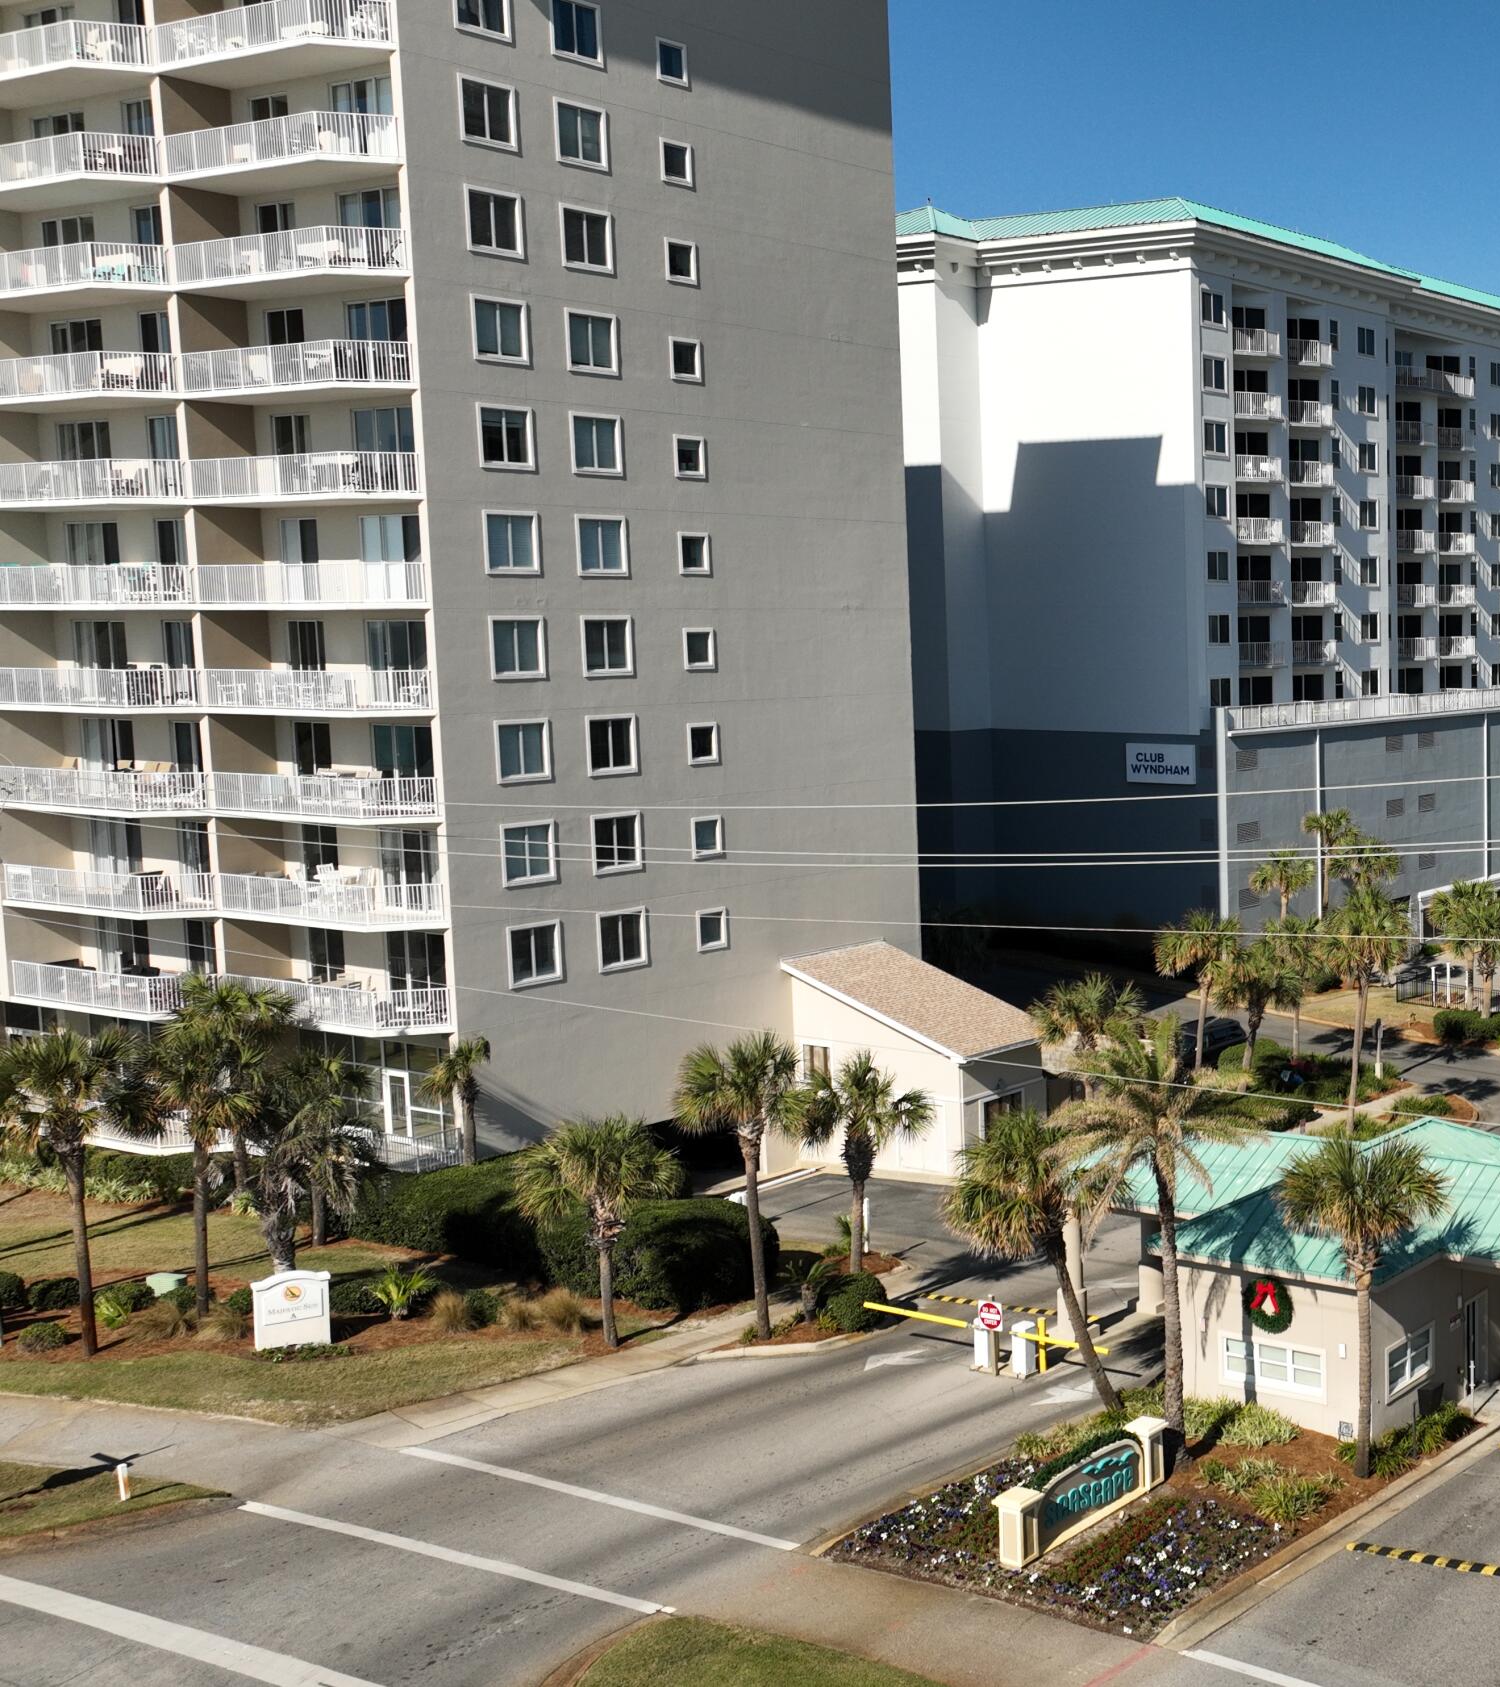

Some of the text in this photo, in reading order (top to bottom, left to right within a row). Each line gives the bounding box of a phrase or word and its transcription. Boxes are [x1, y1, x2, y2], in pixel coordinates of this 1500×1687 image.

[1136, 752, 1165, 763] CLUB
[1131, 763, 1190, 775] WYNDHAM
[984, 1318, 998, 1326] ENTER
[1044, 1464, 1134, 1529] SEASCAPE
